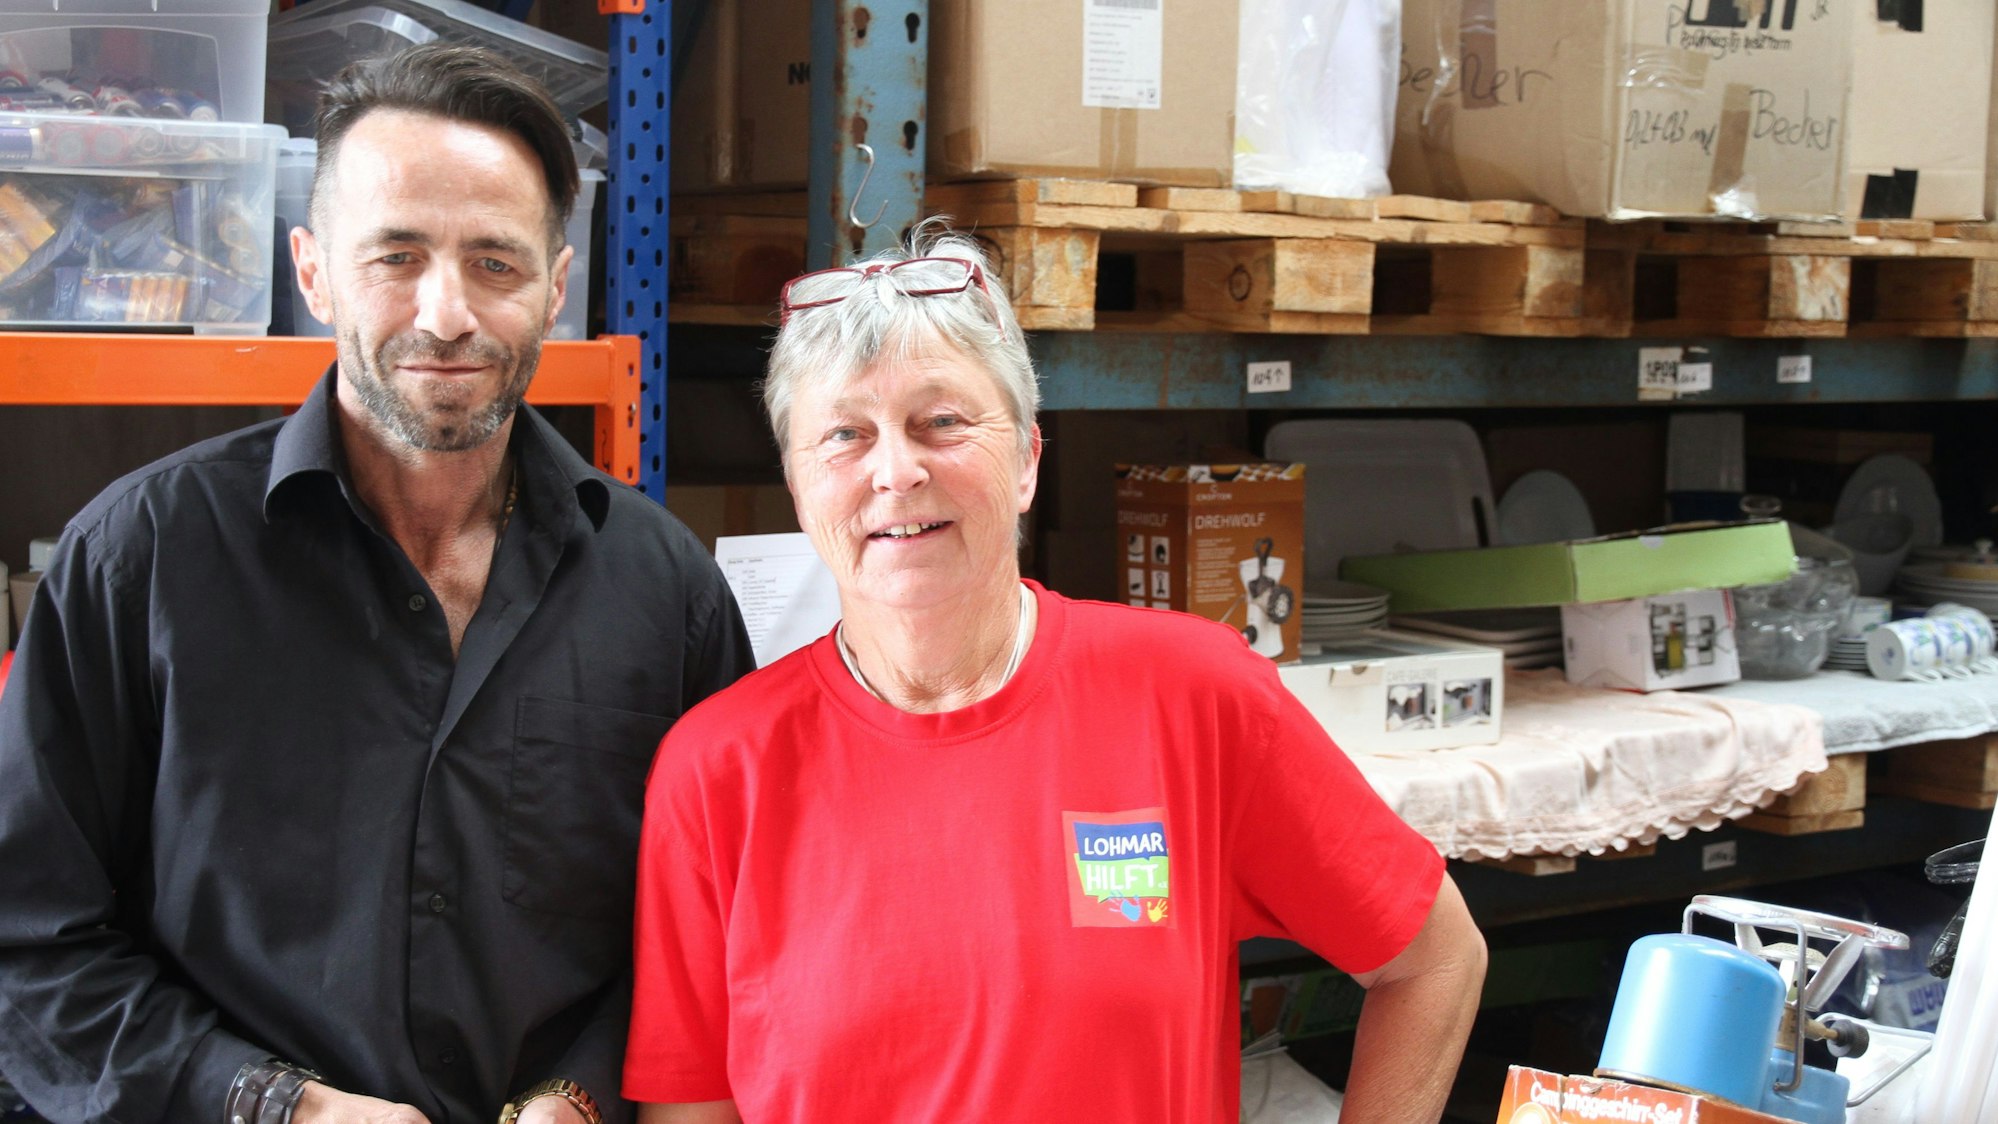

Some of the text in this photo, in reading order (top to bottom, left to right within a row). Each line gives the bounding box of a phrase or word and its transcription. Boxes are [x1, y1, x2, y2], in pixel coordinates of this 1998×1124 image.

[788, 62, 811, 85] N
[1194, 512, 1266, 530] DREHWOLF
[1083, 831, 1165, 857] LOHMAR
[1085, 862, 1159, 892] HILFT
